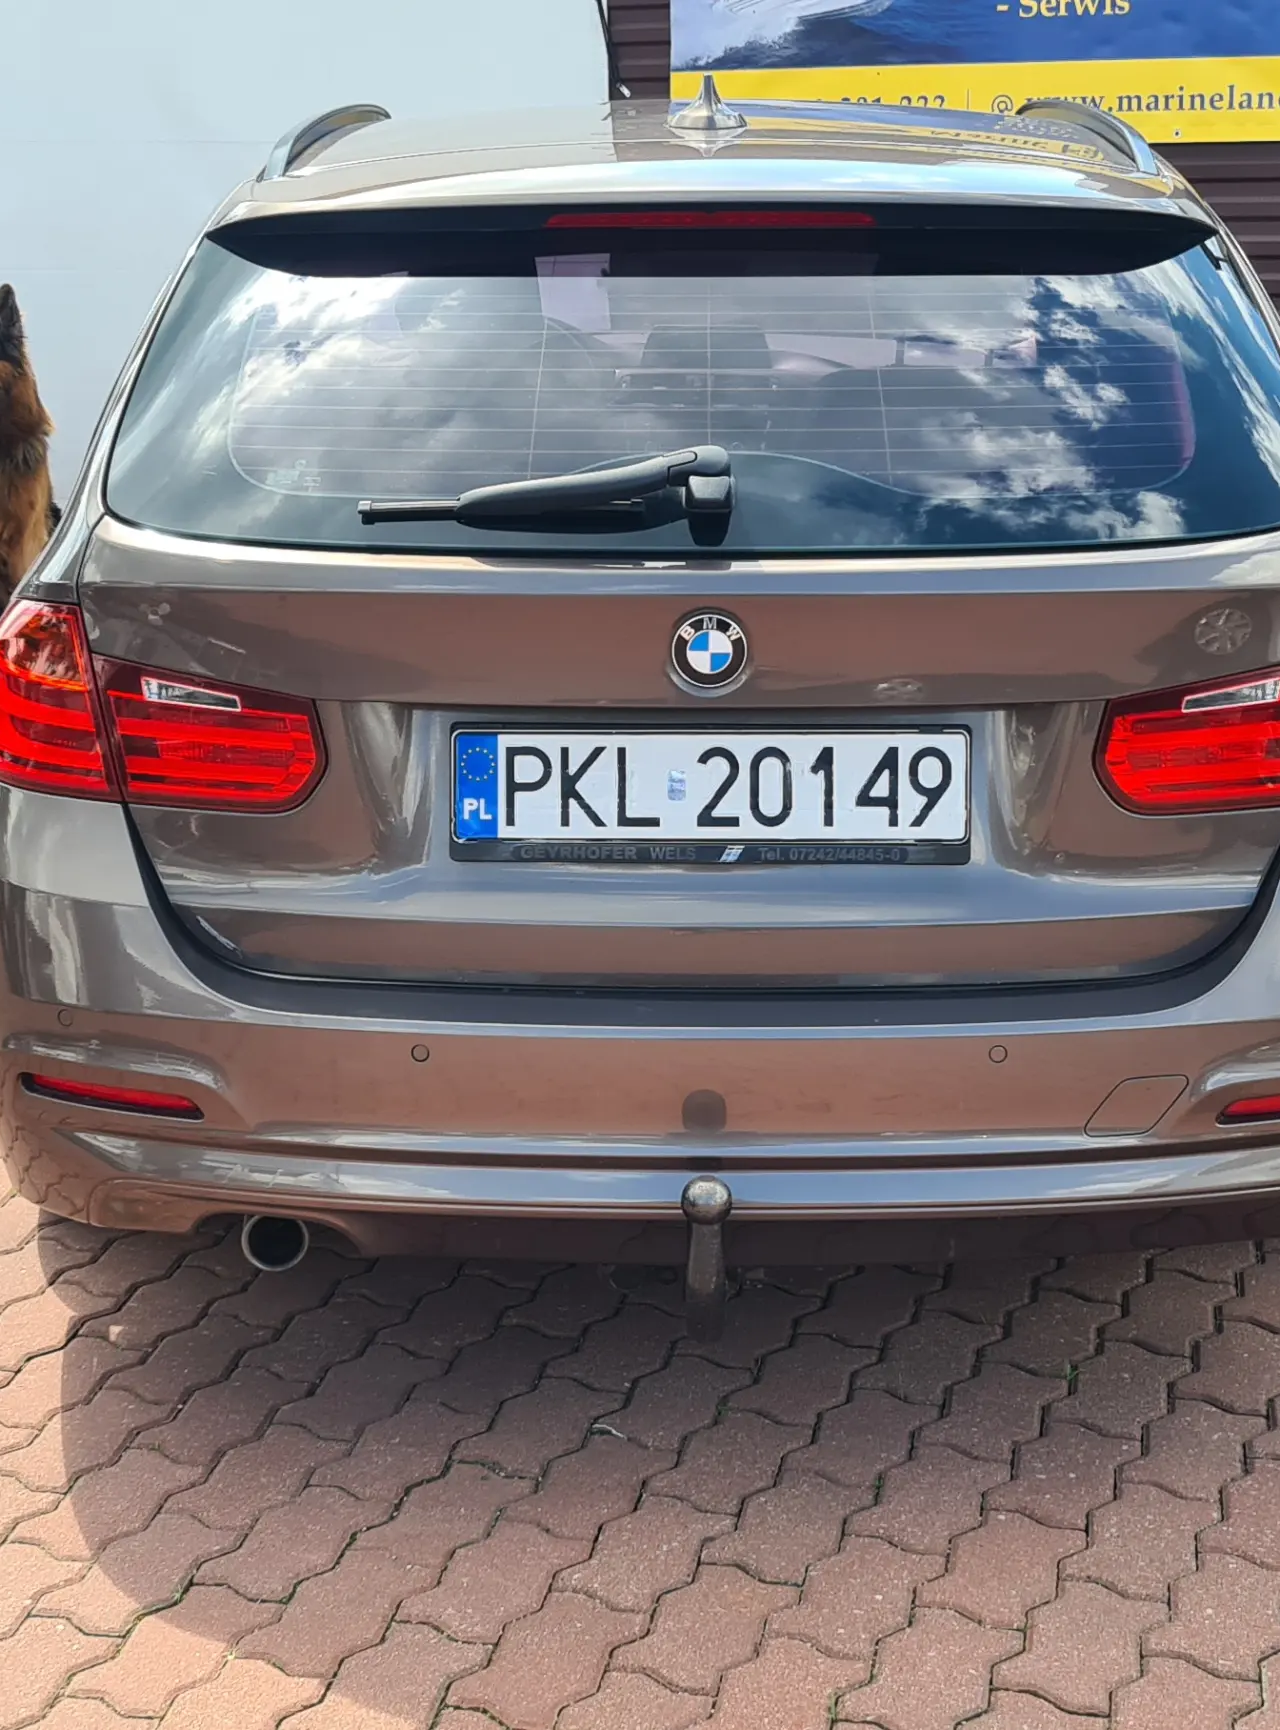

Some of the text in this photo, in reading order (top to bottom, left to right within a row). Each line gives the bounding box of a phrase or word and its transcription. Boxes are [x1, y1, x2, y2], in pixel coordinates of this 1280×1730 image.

[1019, 0, 1131, 18] Serwis
[680, 616, 742, 641] BMW
[505, 746, 953, 828] PKL 20149
[463, 798, 492, 820] PL
[520, 845, 901, 862] GEYRHOFER WELS Tel. 07242/44845-0
